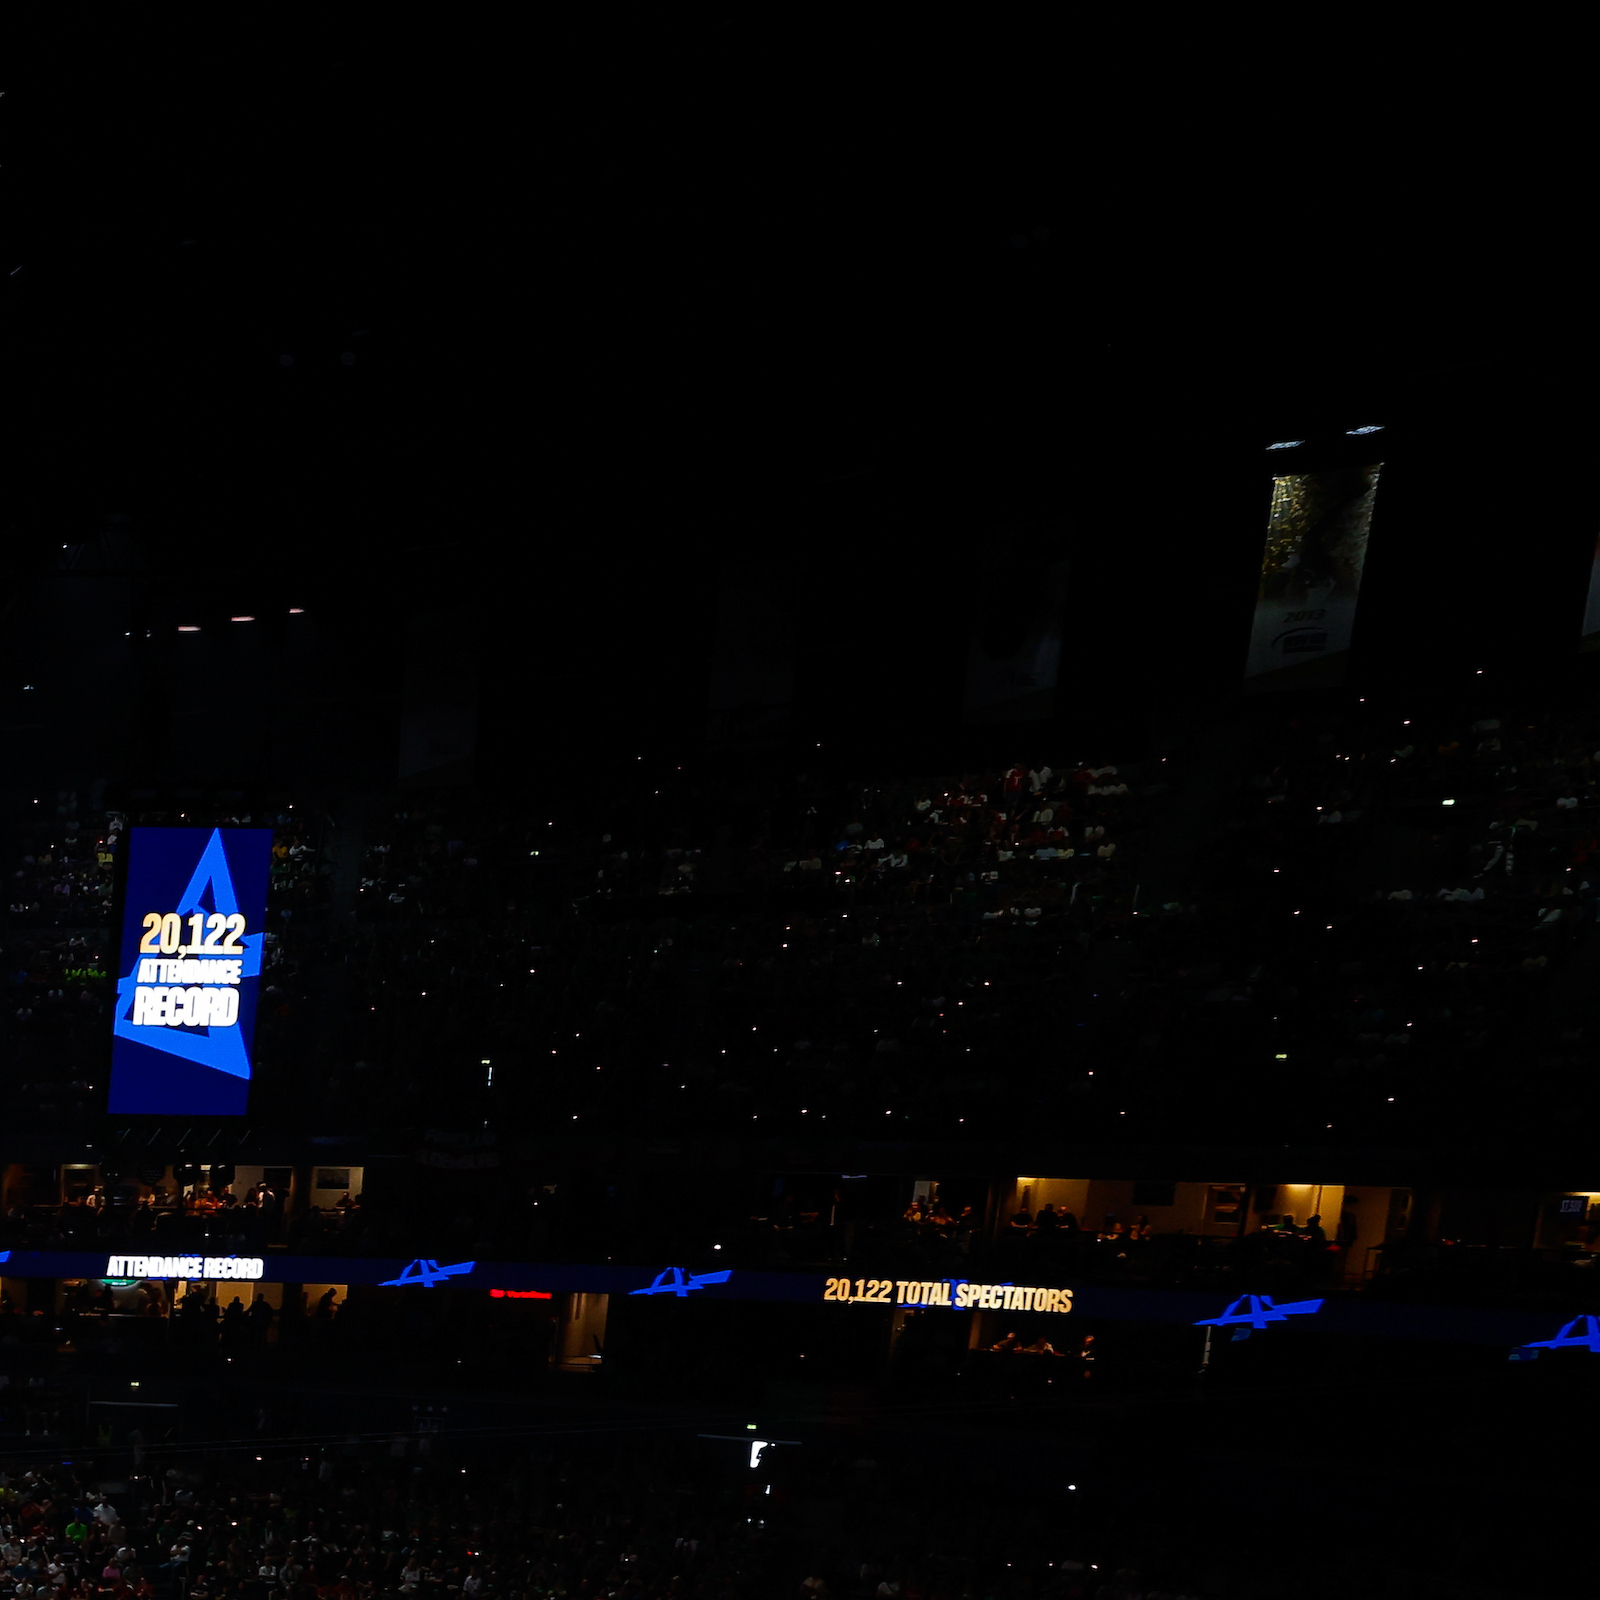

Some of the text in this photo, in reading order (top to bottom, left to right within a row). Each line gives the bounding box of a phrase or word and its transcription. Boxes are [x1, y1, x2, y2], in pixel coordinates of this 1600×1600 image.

[140, 912, 245, 959] 20,122
[137, 959, 242, 985] ATTENDANCE
[132, 986, 239, 1027] RECORD
[106, 1256, 264, 1279] ATTENDANCE RECORD
[824, 1277, 1074, 1314] 20,122 TOTAL SPECTATORS
